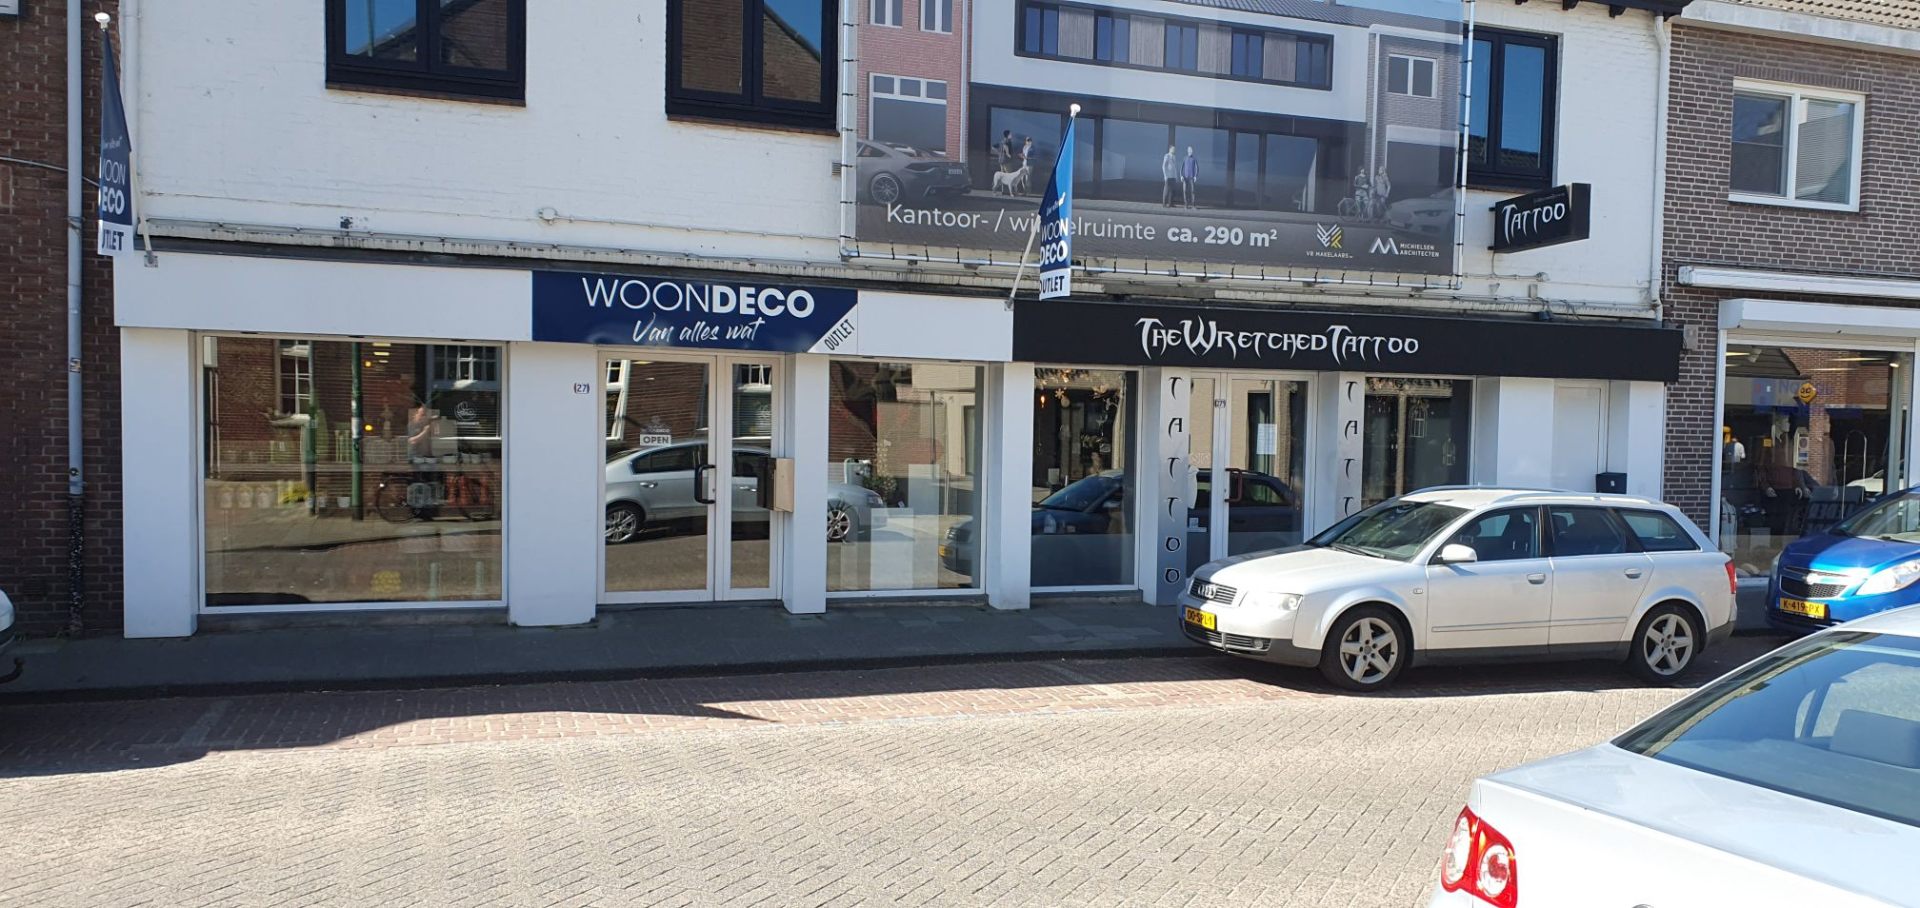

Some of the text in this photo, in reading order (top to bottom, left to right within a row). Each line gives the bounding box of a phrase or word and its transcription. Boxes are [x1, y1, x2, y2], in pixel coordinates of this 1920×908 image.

[102, 186, 125, 215] ECO
[887, 203, 989, 229] Kantoor-
[1167, 226, 1198, 243] ca.
[1204, 226, 1244, 246] 290
[1040, 239, 1068, 267] DECO
[1400, 243, 1435, 251] MICHIELSEN
[1400, 250, 1440, 258] ARCHITECTEN
[582, 277, 815, 318] WOONDECO
[632, 313, 766, 342] Van alles wat
[824, 319, 856, 351] OUTLET
[643, 435, 669, 444] OPEN
